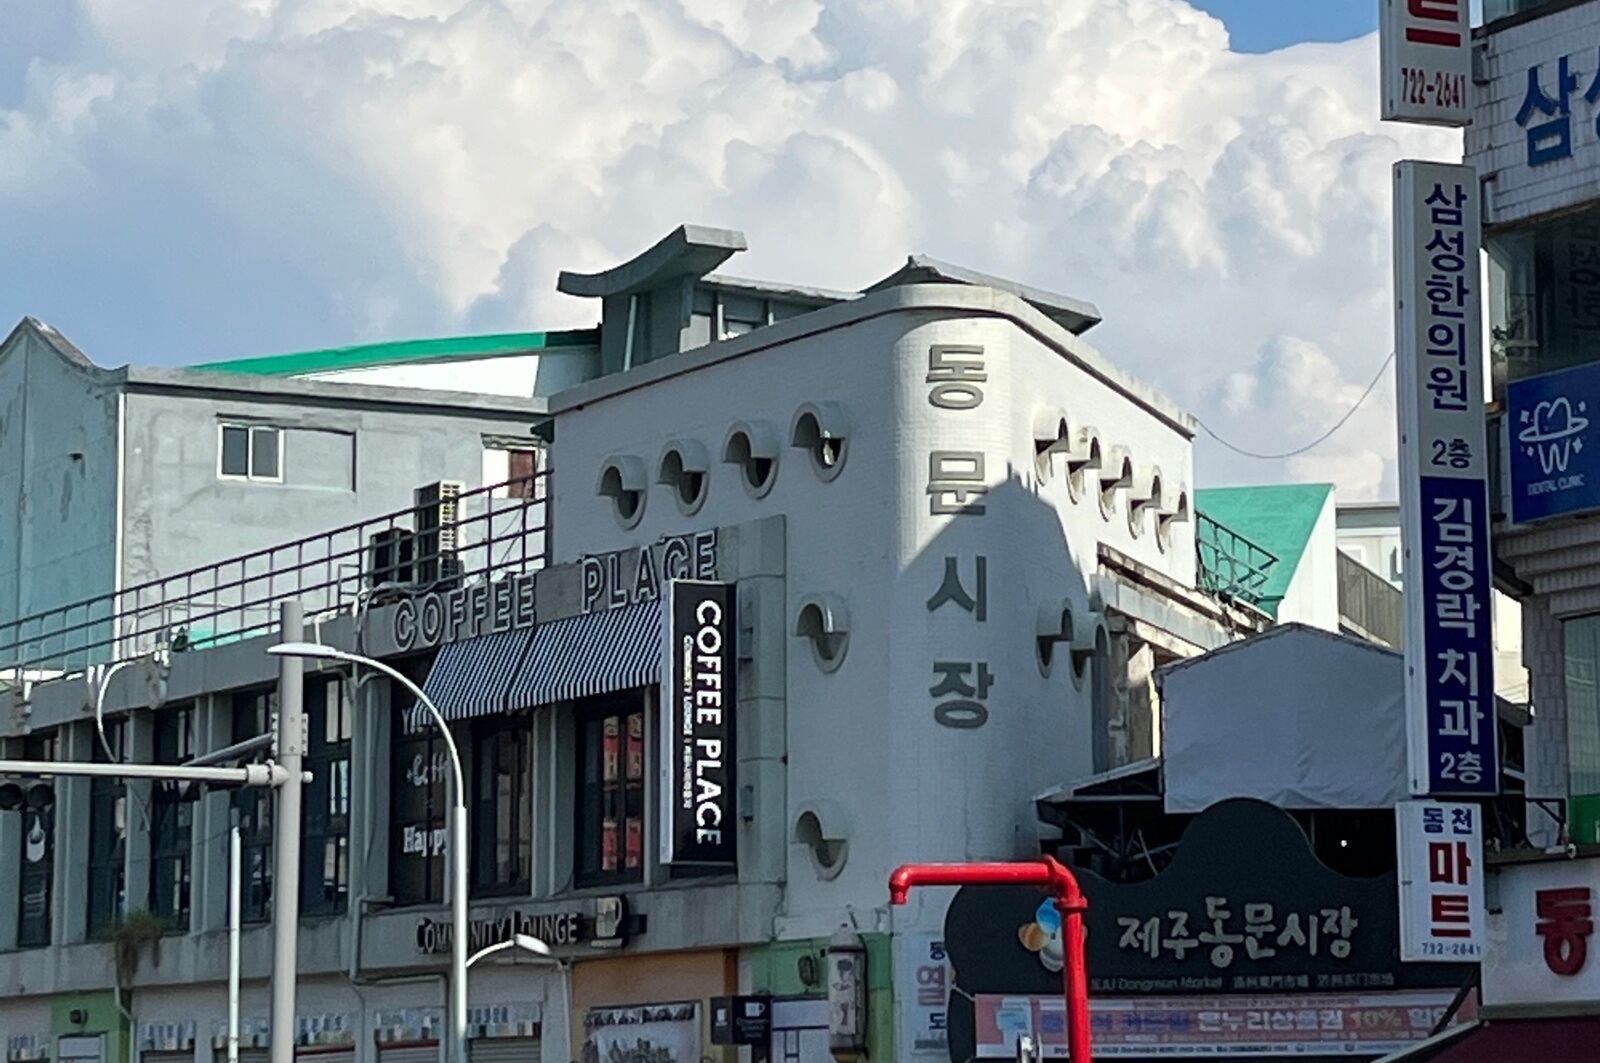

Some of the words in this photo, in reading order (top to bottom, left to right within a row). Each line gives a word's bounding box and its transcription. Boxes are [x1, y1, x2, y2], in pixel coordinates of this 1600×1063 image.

[1401, 68, 1467, 109] 722-2641
[1424, 183, 1472, 412] 삼성한의원
[1431, 438, 1473, 469] 2층
[926, 344, 994, 730] 동문시장
[394, 576, 536, 652] COFFEE
[581, 528, 718, 614] PLACE
[696, 600, 721, 725] COFFEE
[696, 739, 721, 845] PLACE
[1439, 751, 1484, 784] 2층
[1117, 896, 1359, 968] 제주동문시장
[1429, 841, 1472, 938] 마트
[1535, 887, 1594, 976] 동
[1350, 1009, 1402, 1030] 10%
